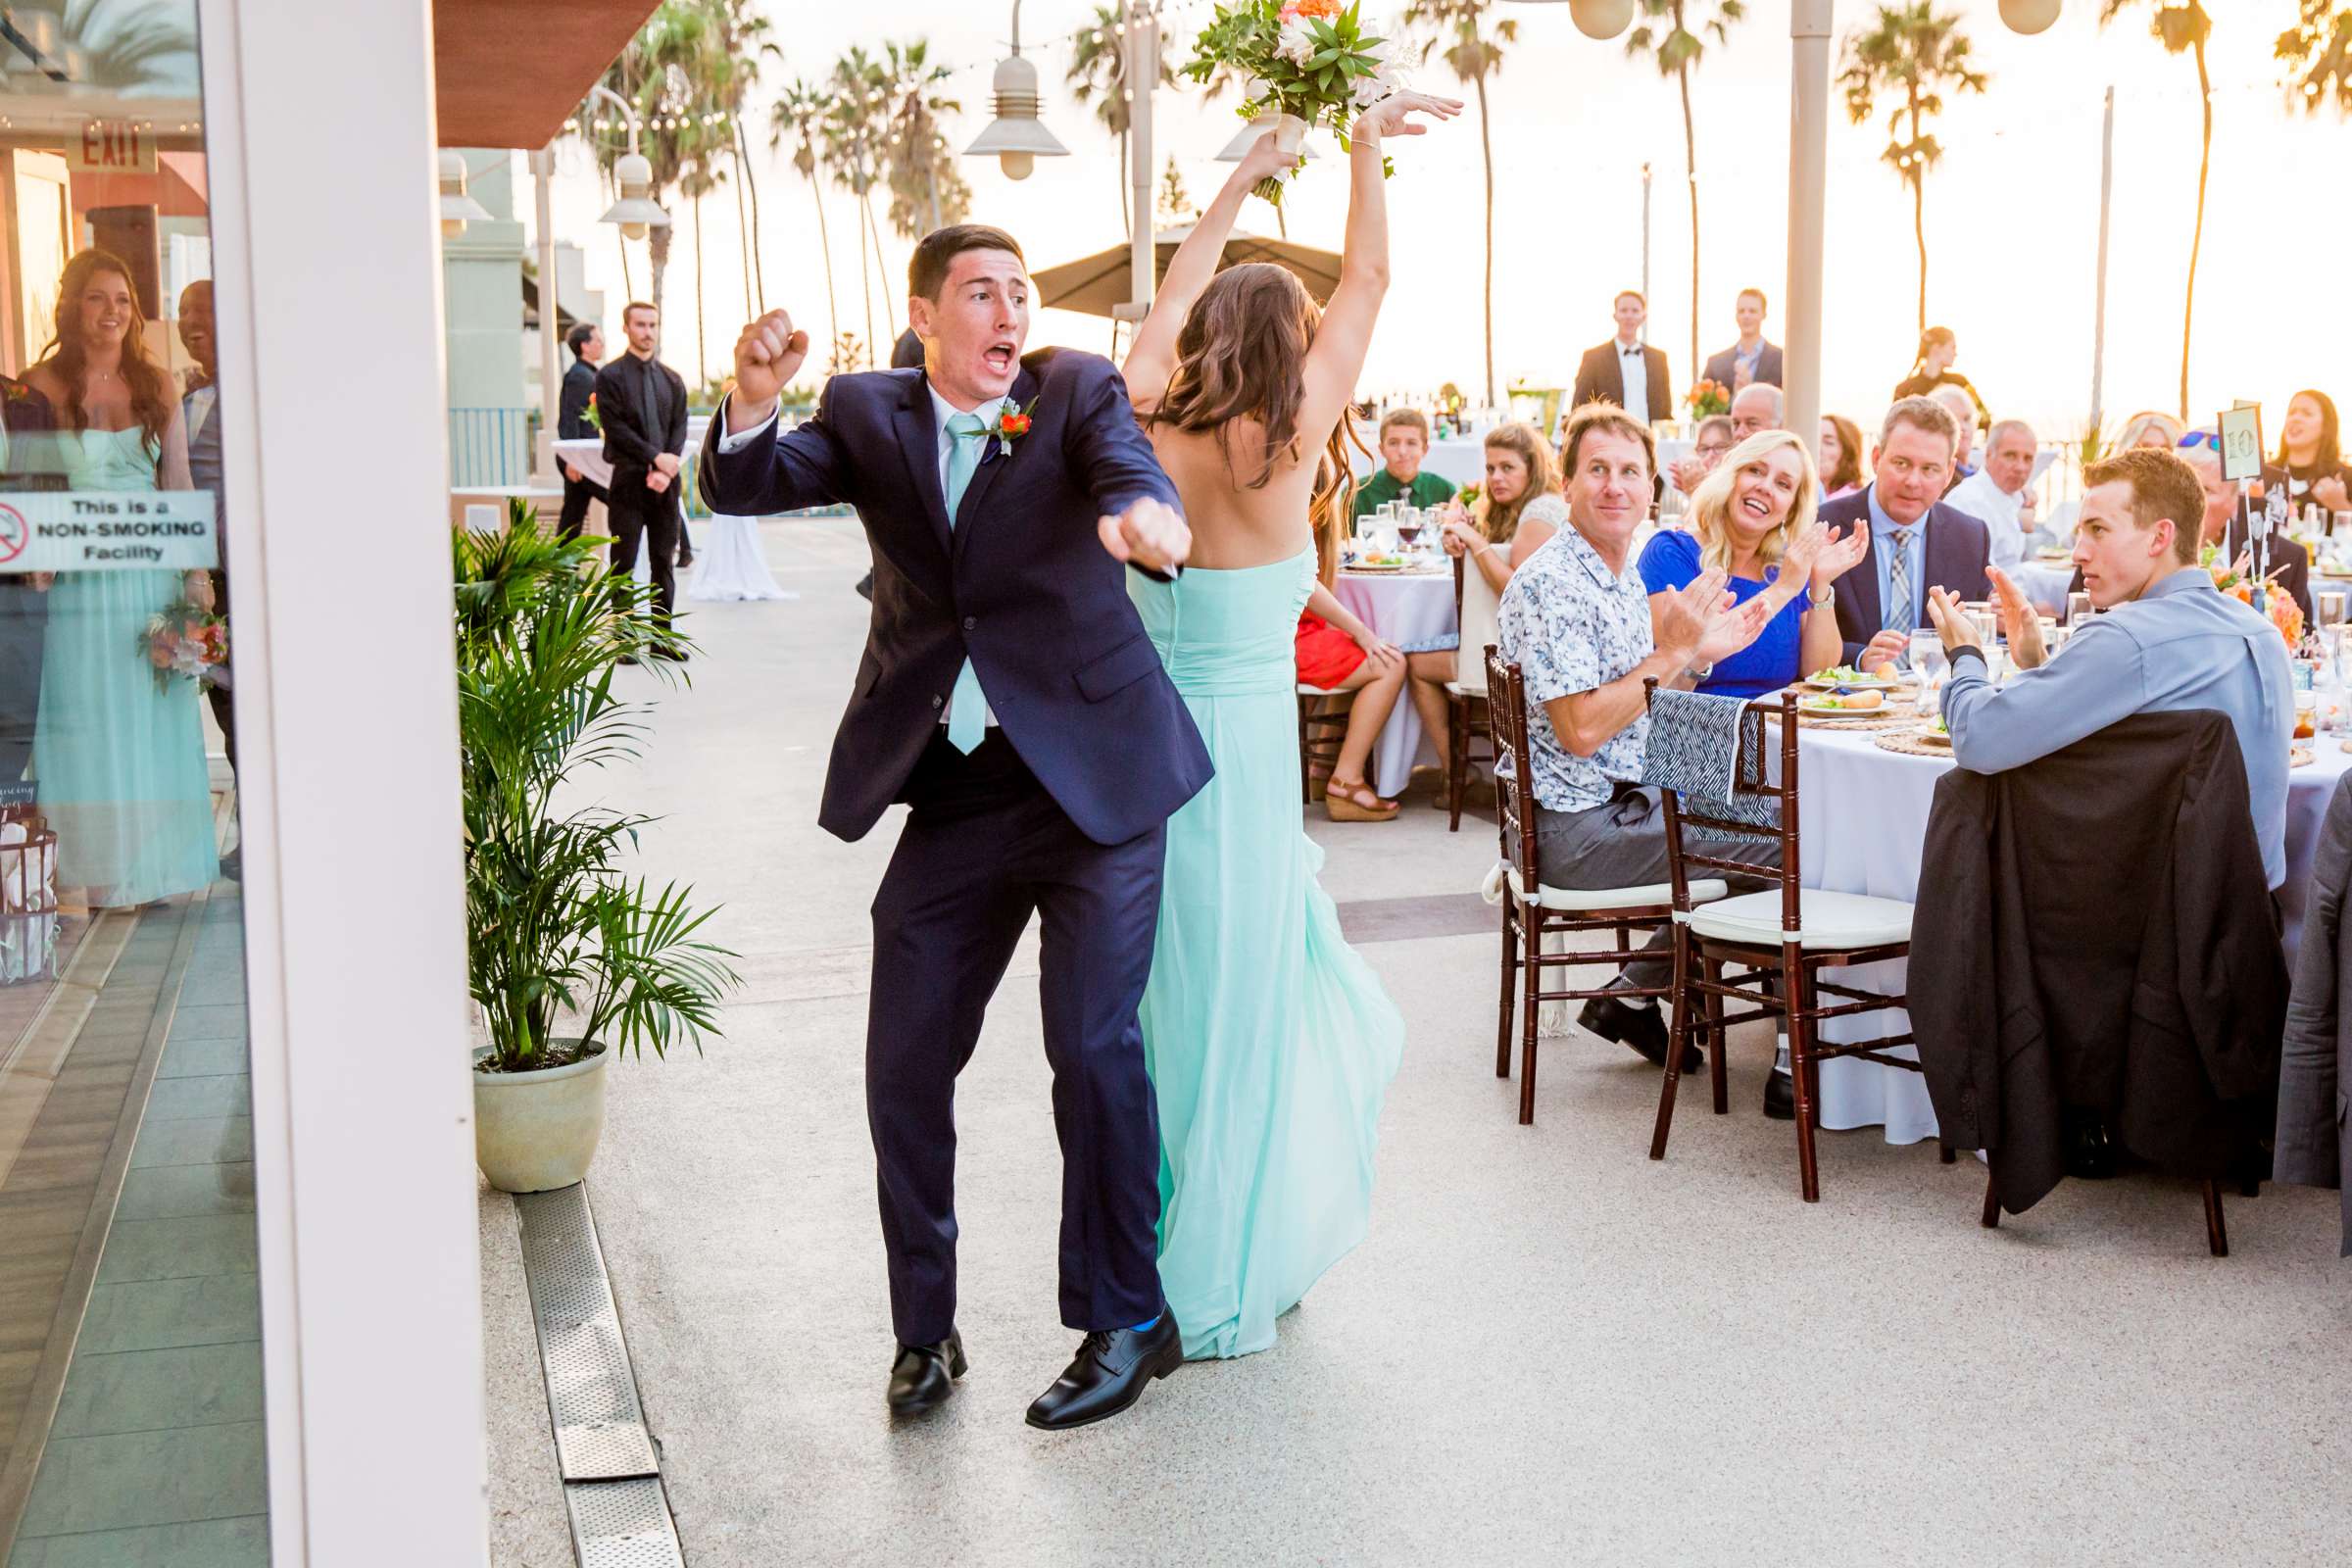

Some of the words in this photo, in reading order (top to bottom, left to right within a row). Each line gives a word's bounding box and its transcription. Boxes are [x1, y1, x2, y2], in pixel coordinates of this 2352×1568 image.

[81, 120, 141, 166] EXIT
[2227, 429, 2255, 459] 10
[72, 500, 120, 514] This
[126, 499, 147, 514] is
[155, 501, 170, 514] a
[36, 521, 206, 538] NON-SMOKING
[83, 545, 165, 563] Facility
